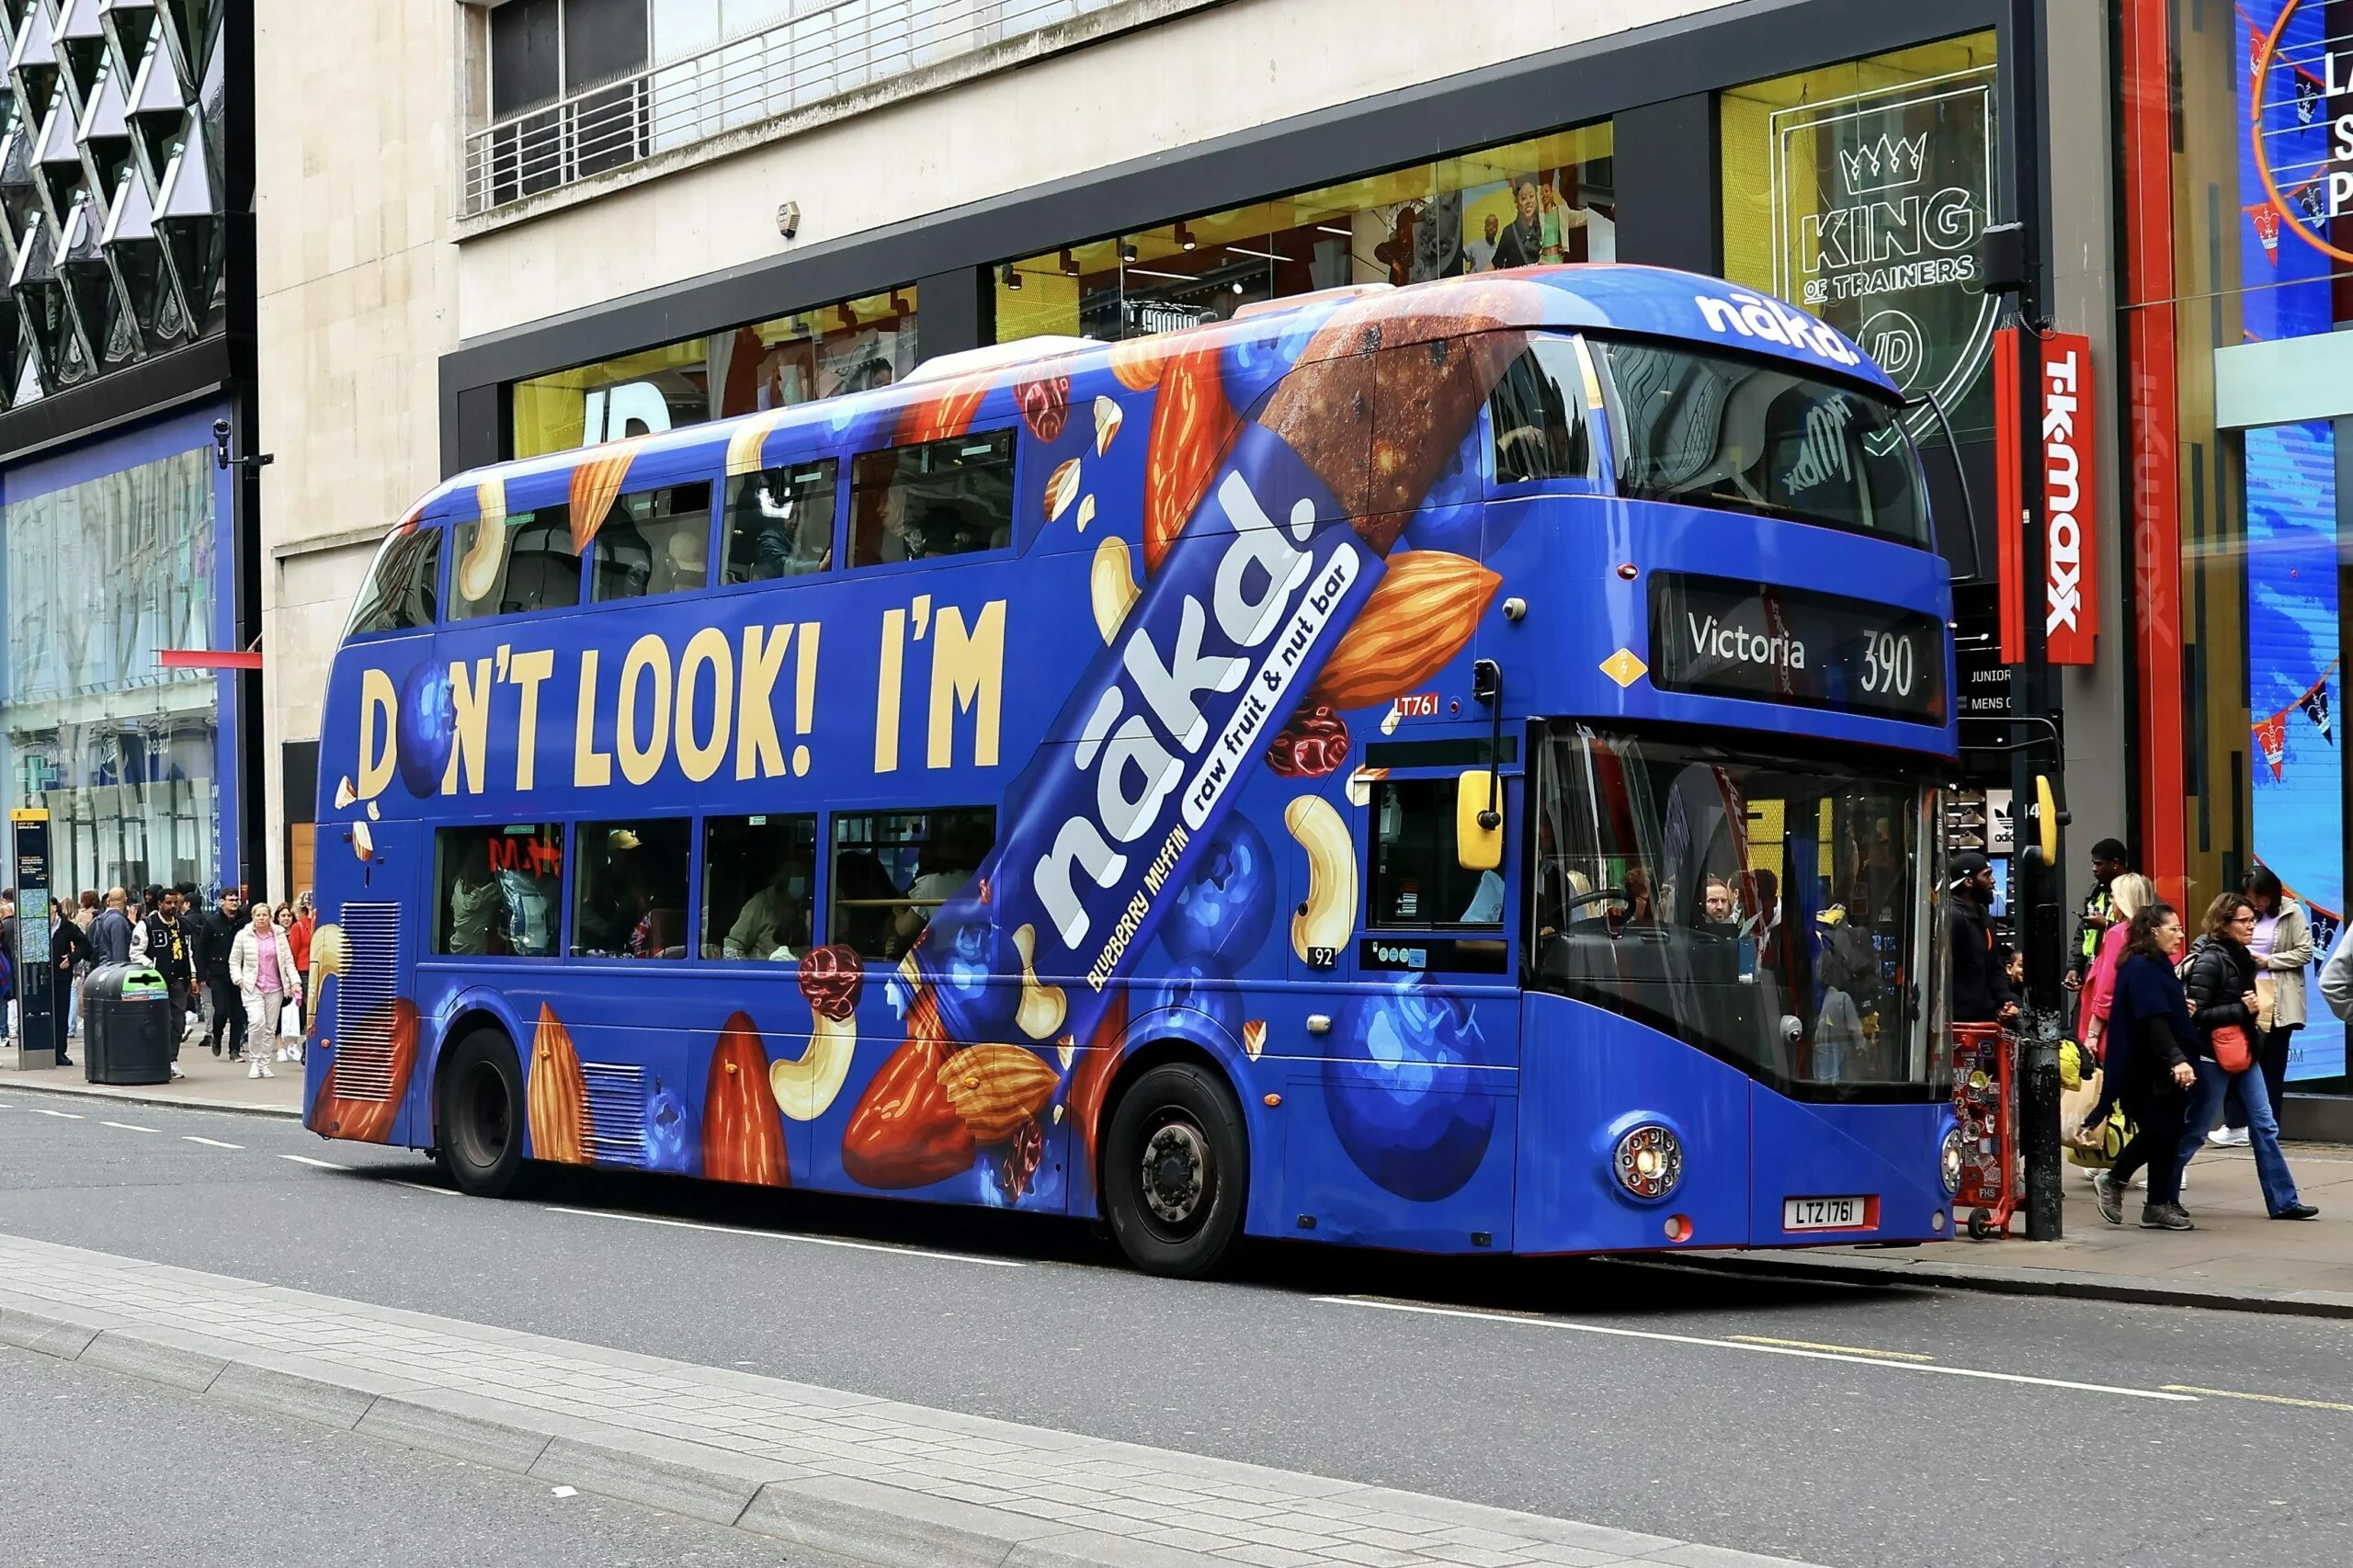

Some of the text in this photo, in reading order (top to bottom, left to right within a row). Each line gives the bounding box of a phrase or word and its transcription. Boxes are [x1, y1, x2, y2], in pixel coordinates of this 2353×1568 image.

[2325, 51, 2353, 97] L
[1802, 187, 1973, 273] KING
[1803, 255, 1975, 304] OF TRAINERS
[1688, 611, 1806, 670] Victoria
[1860, 628, 1914, 697] 390
[574, 621, 821, 788] LOOK!
[874, 594, 1007, 774] I'M
[1193, 563, 1347, 812] raw fruit & nut bar
[1393, 695, 1438, 717] LT761
[1972, 697, 2004, 710] MENS
[152, 929, 168, 948] B
[1315, 948, 1333, 965] 92
